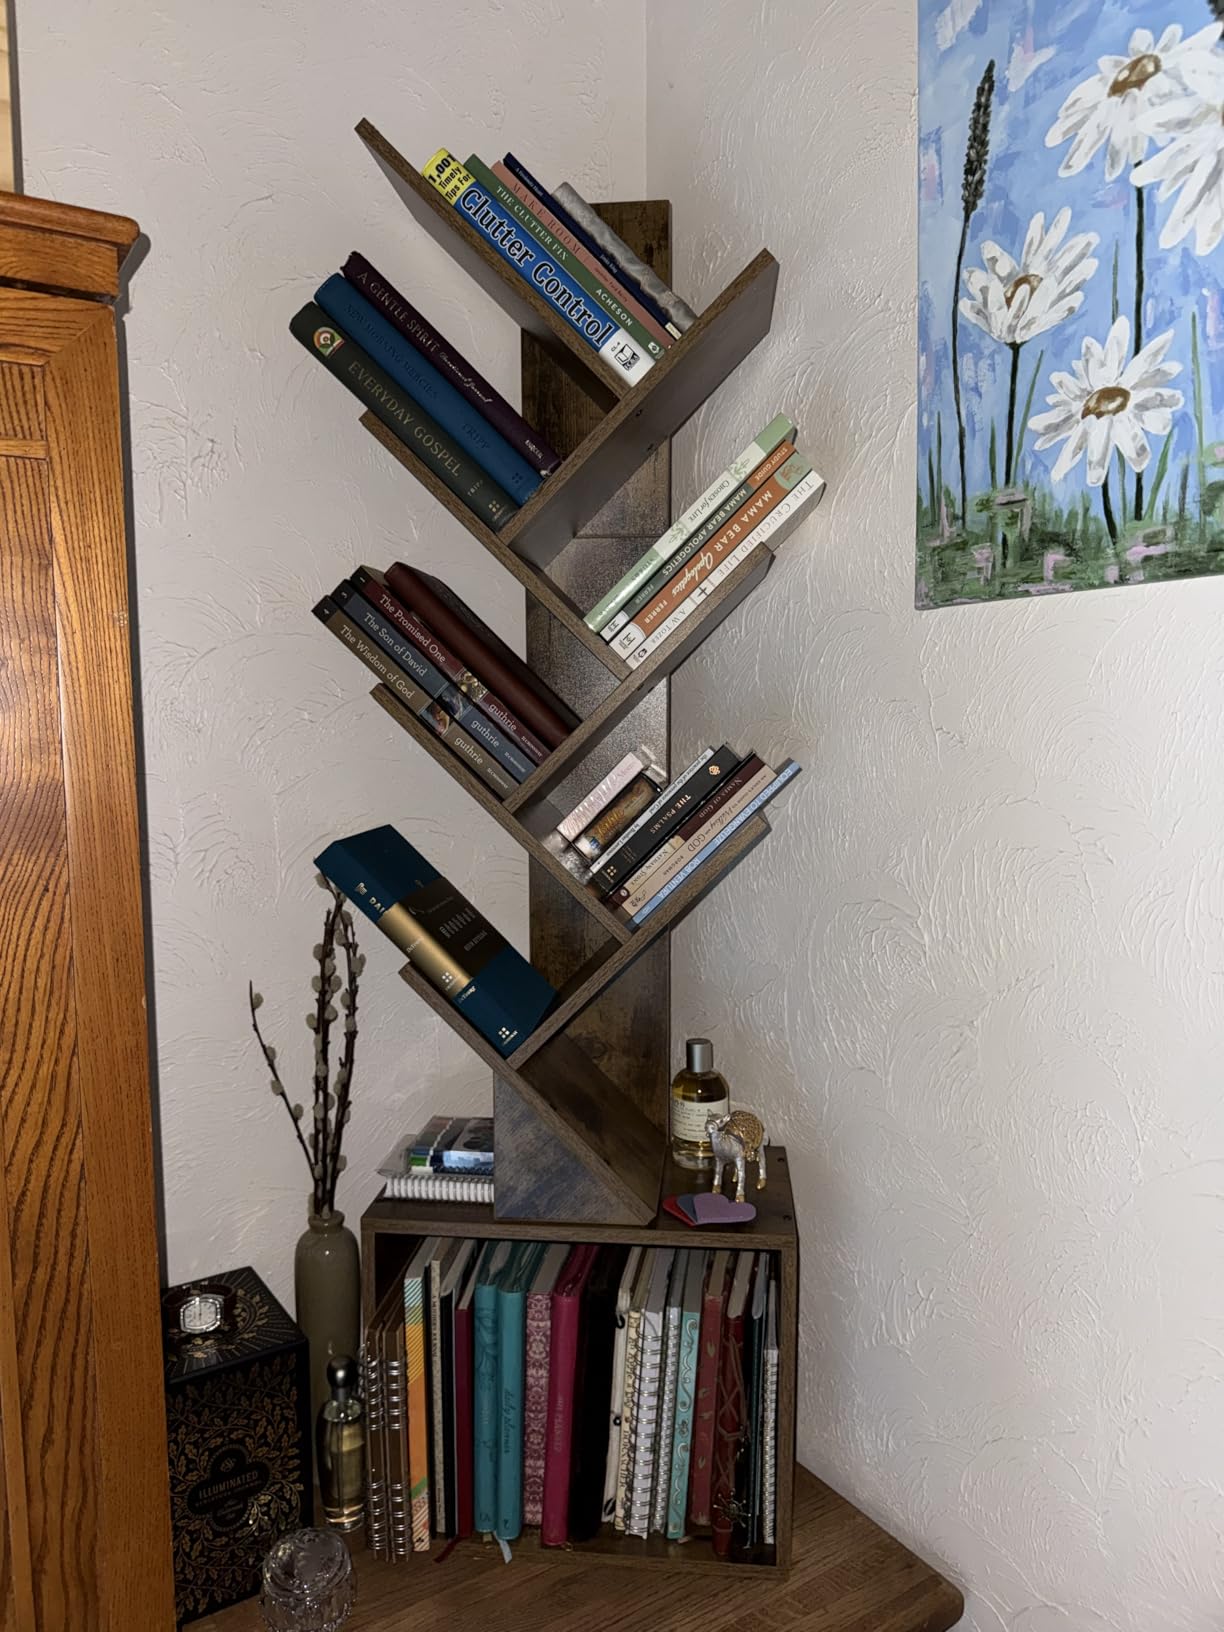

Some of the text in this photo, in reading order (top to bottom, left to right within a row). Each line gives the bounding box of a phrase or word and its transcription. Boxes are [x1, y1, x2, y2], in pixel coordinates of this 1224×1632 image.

[428, 154, 455, 183] 1,001
[439, 167, 462, 189] Timely
[445, 173, 472, 201] Tips For
[494, 185, 568, 260] THE CLUTTER FIX
[511, 184, 582, 253] MAKE ROOM
[457, 187, 616, 346] Clutter Control
[355, 269, 370, 284] A
[367, 280, 408, 321] GENTLE
[405, 318, 440, 353] SPIRIT
[595, 288, 633, 326] ACHESON
[346, 360, 463, 475] EVERYDAY GOSPEL
[754, 446, 788, 480] STUDY GUIDE
[696, 497, 712, 512] for
[662, 489, 746, 574] MAMA BEAR APOLOGETICS
[716, 480, 813, 577] THE CRUCIFIED LIFE
[666, 490, 772, 600] MAMA BEAR Apologetics
[644, 600, 667, 623] FERRER
[378, 594, 447, 662] The Promised One
[362, 612, 427, 676] The Son of David
[339, 624, 415, 698] The Wisdom of God
[488, 702, 518, 732] guthrie
[470, 718, 501, 748] guthrie
[453, 735, 484, 765] guthrie
[700, 753, 709, 762] the
[676, 778, 684, 786] the
[648, 803, 659, 814] God
[674, 792, 691, 810] THE
[698, 777, 741, 819] NAMES OF GOD
[713, 768, 793, 845] EQUIPPED TO EVANGELIZE
[632, 822, 640, 830] by
[649, 807, 675, 834] PSALMS
[708, 804, 733, 831] Walking
[686, 832, 705, 852] GOD
[657, 856, 701, 899] ROB VENTURA
[196, 1470, 259, 1499] ILLUMINATED
